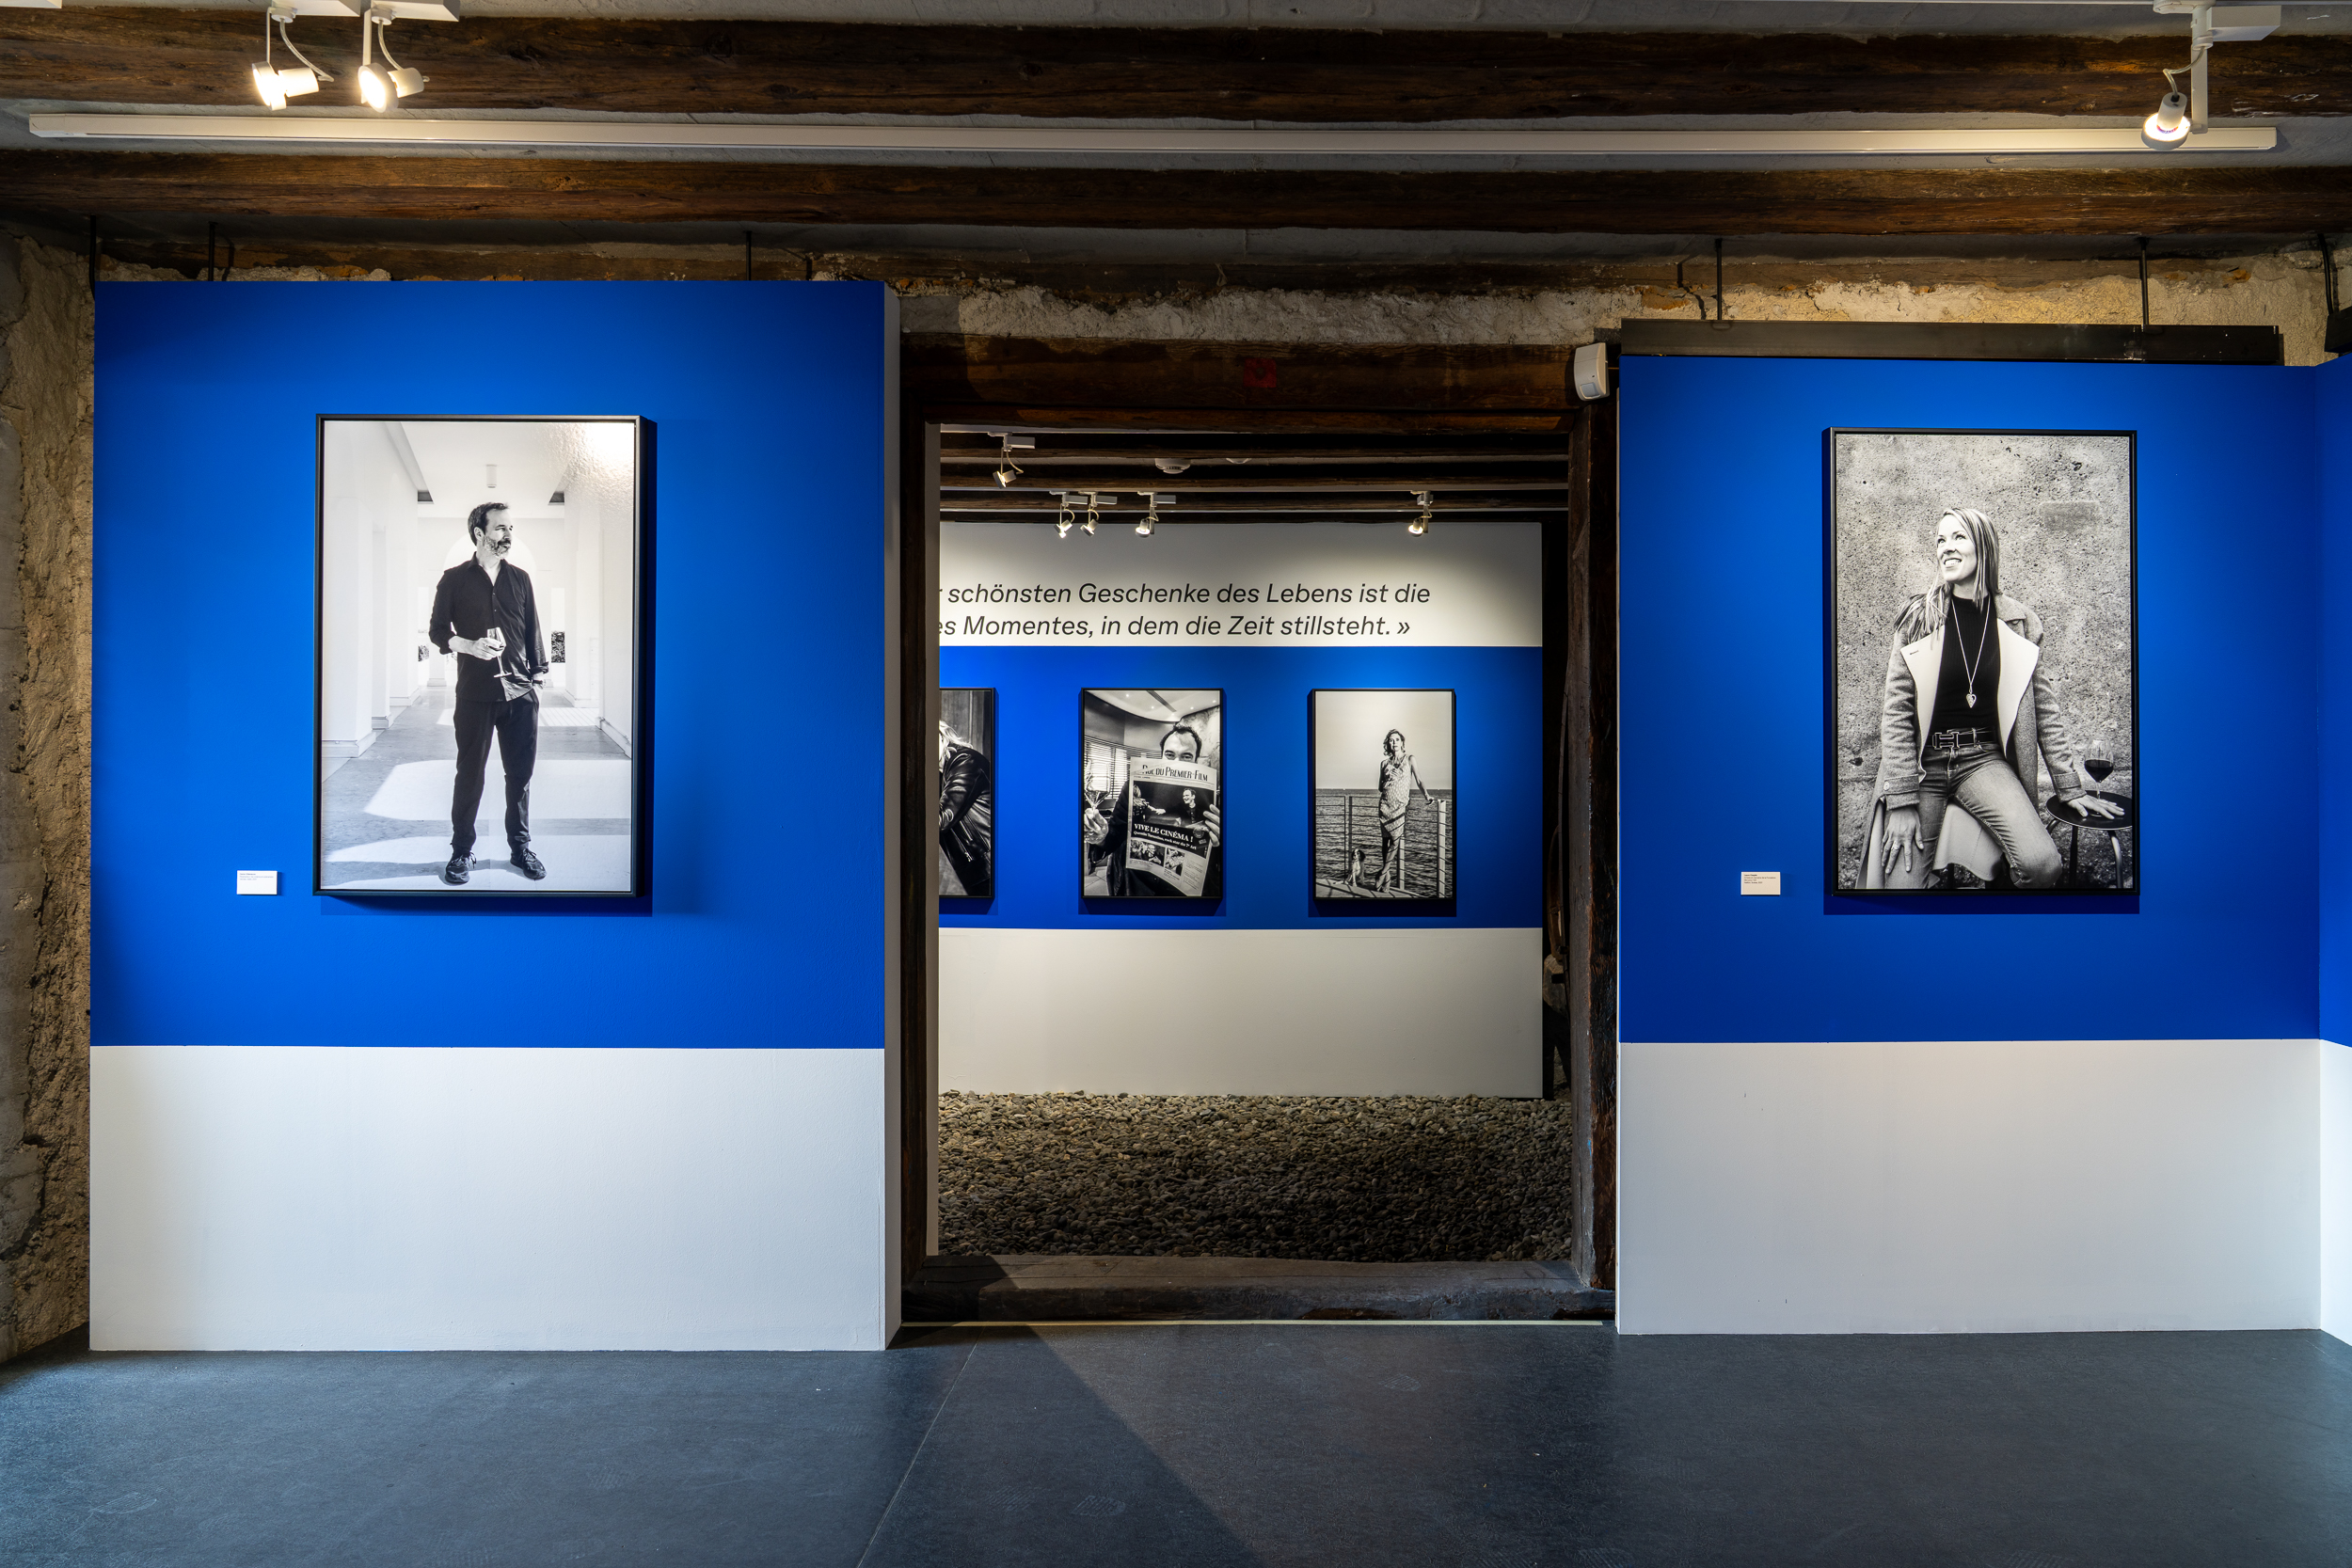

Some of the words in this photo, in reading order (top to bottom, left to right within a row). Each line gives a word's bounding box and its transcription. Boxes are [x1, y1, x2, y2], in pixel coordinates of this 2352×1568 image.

[947, 583, 1072, 603] schönsten
[1078, 582, 1211, 603] Geschenke
[1216, 582, 1261, 603] des
[1266, 582, 1353, 603] Lebens
[1359, 583, 1389, 603] ist
[1394, 583, 1430, 603] die
[963, 615, 1093, 639] Momentes,
[1101, 615, 1120, 635] in
[1128, 615, 1179, 635] dem
[1185, 615, 1221, 635] die
[1227, 615, 1275, 635] Zeit
[1279, 615, 1391, 635] stillsteht.
[1134, 823, 1150, 832] VIVE
[1150, 826, 1160, 834] LE
[1159, 829, 1189, 842] CINÉMA
